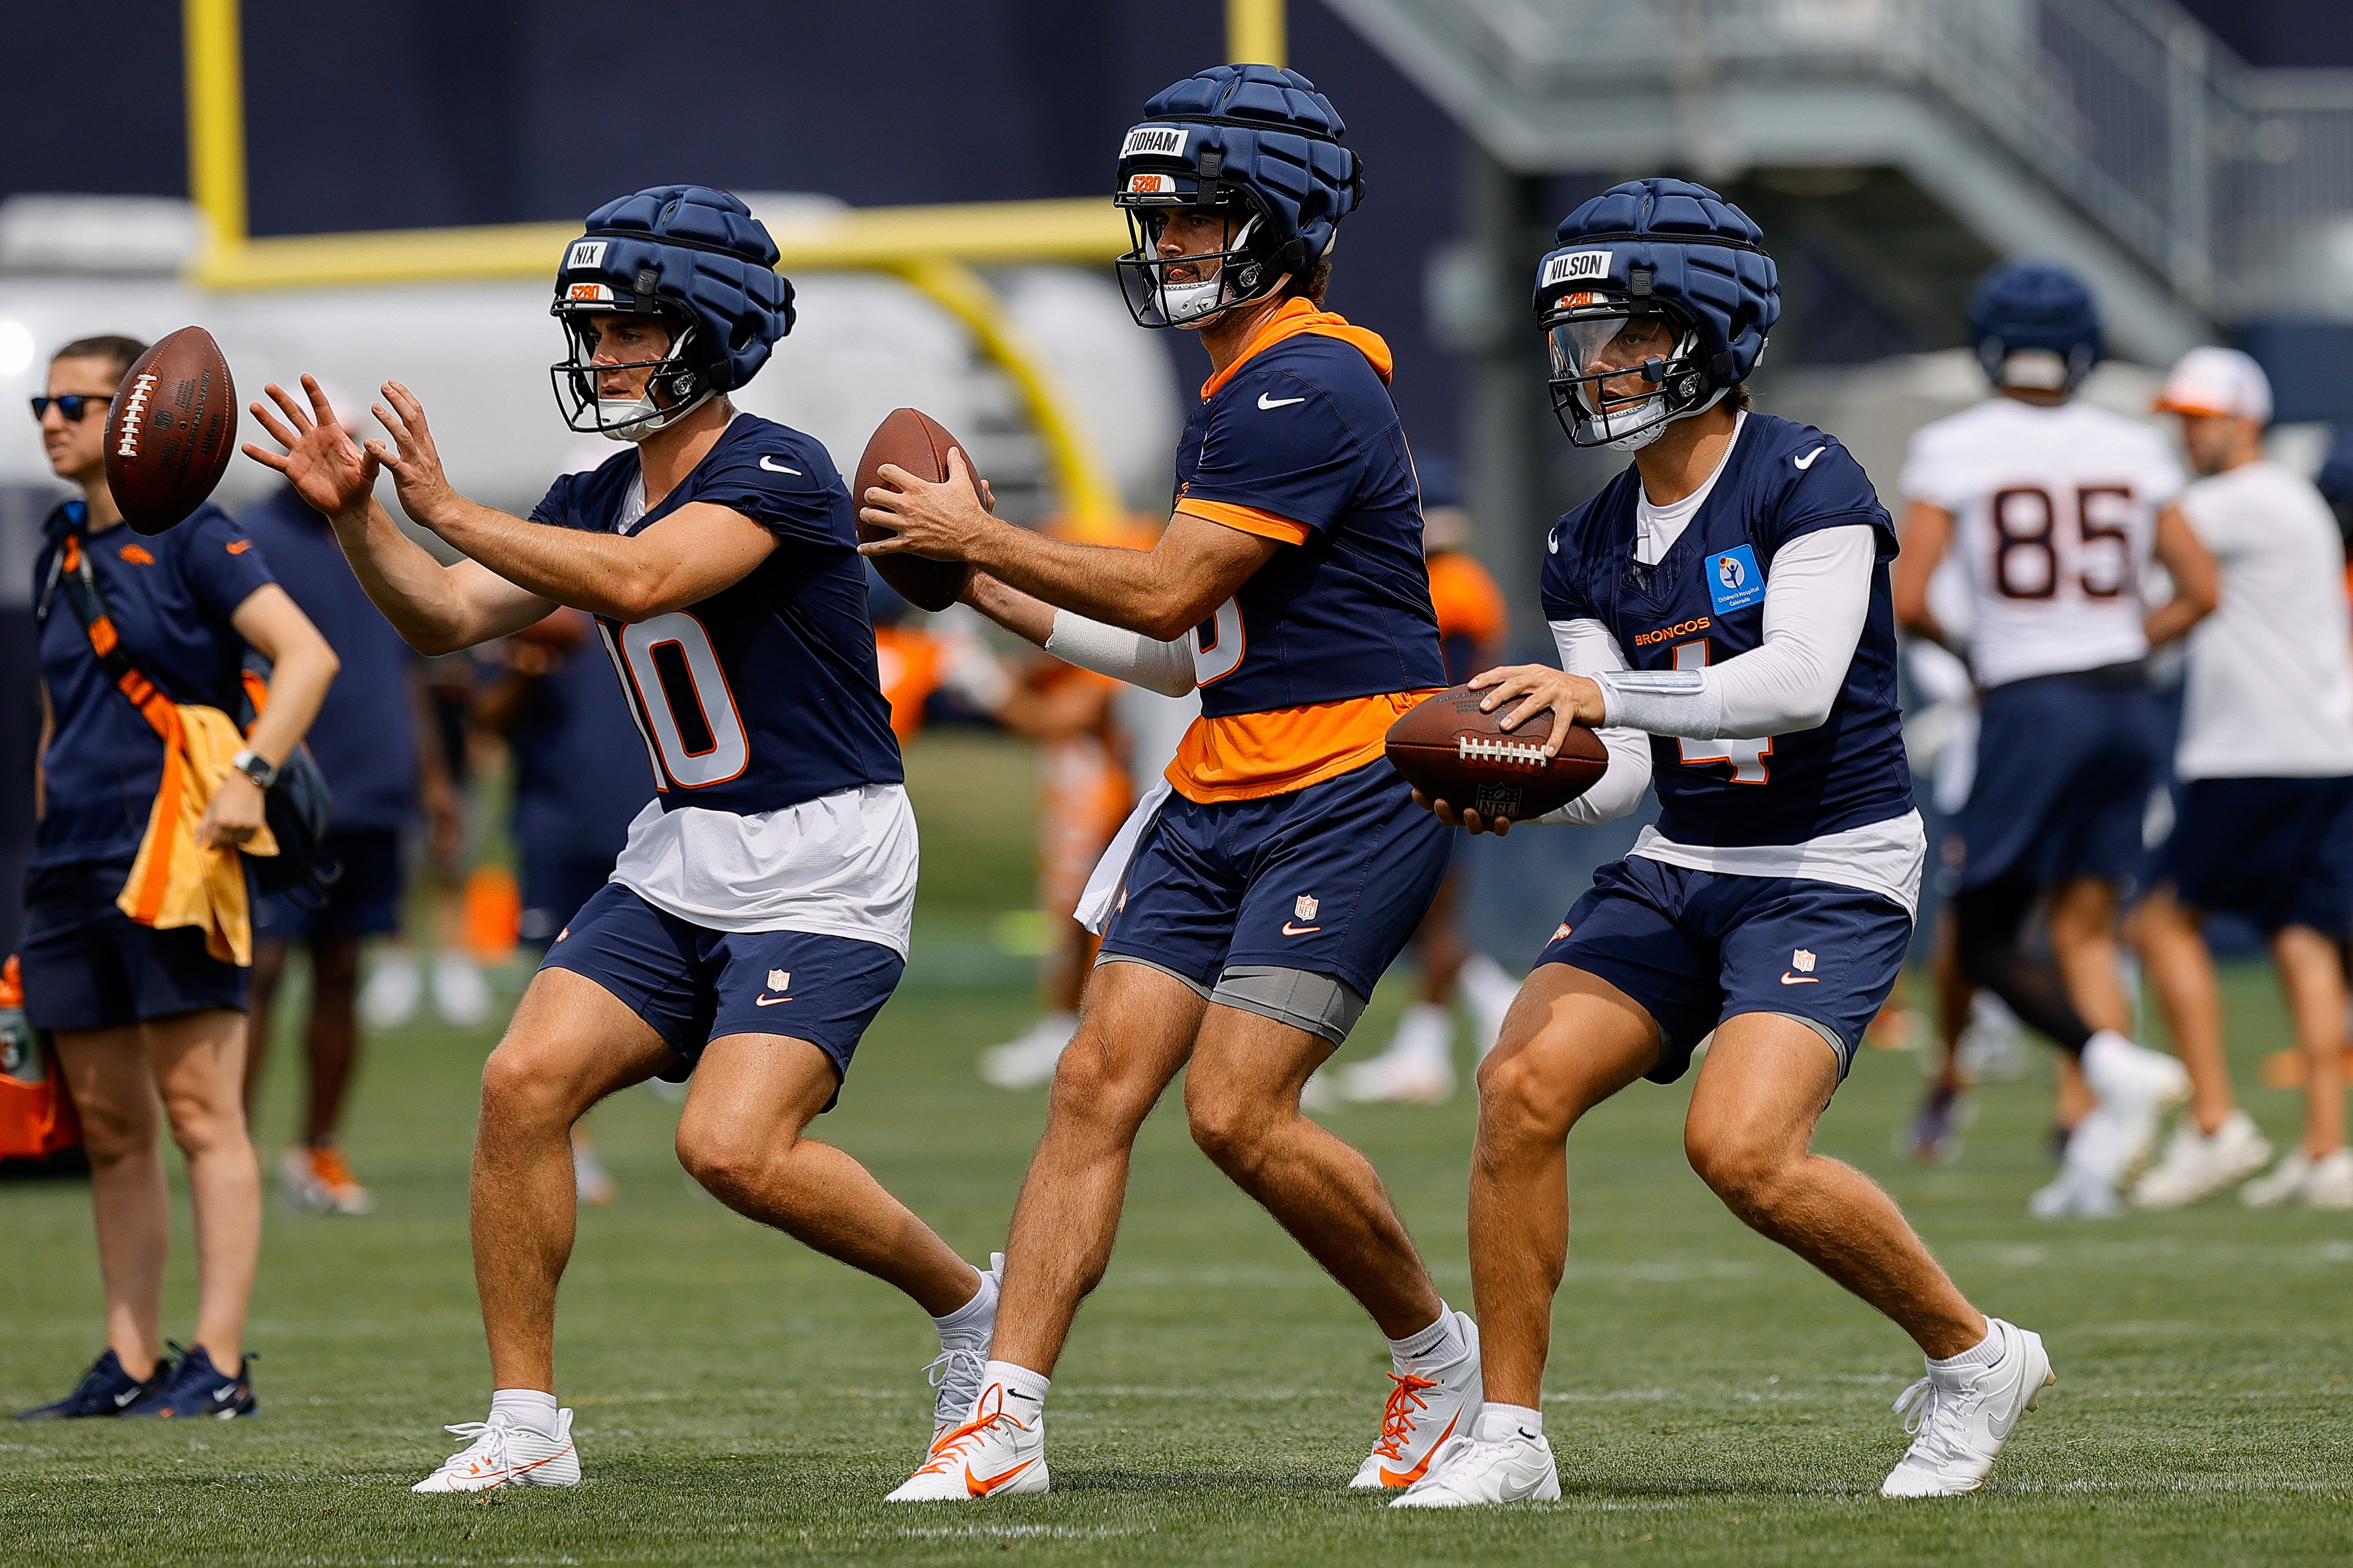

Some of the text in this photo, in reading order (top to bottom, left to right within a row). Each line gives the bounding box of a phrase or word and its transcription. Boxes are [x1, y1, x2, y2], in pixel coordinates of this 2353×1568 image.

[1132, 176, 1161, 192] 5280
[574, 246, 598, 264] NIX
[187, 403, 205, 447] FOOTBALL
[199, 369, 210, 401] LEAGUE
[1993, 486, 2132, 601] 85
[1718, 586, 1760, 603] Children's Hospital
[1729, 597, 1751, 606] Colorado
[1634, 616, 1711, 646] BRONCOS
[595, 610, 749, 793] 10
[1480, 800, 1516, 816] NFL
[1298, 905, 1313, 916] NFL
[770, 978, 785, 988] NFL
